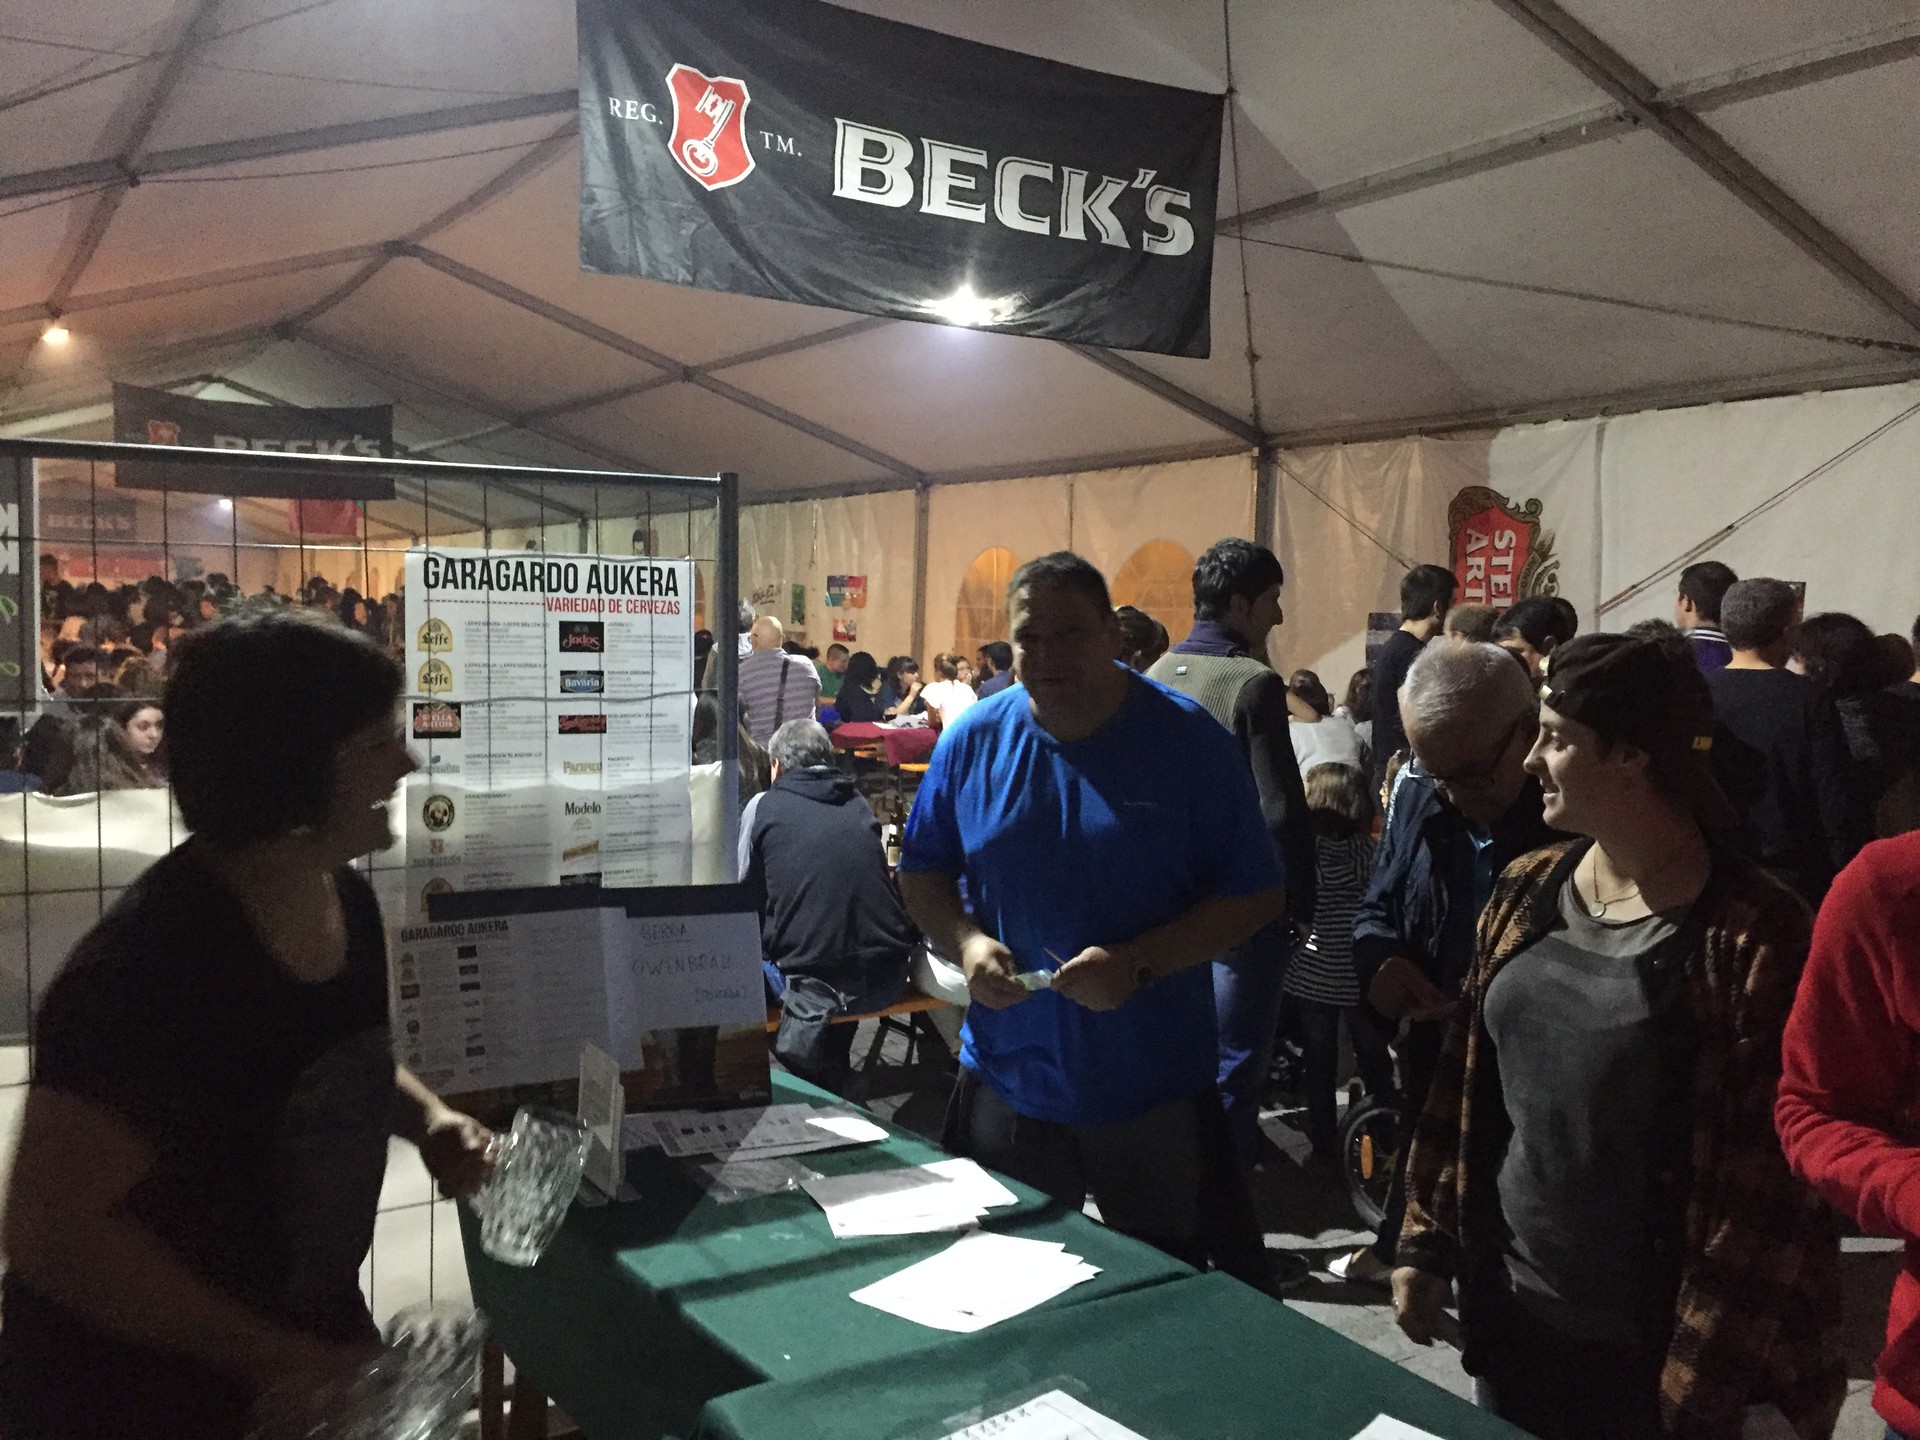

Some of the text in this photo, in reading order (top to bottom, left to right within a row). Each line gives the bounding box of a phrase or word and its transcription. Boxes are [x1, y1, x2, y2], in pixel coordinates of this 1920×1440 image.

[608, 96, 664, 126] REG.
[759, 130, 803, 157] TM.
[832, 117, 1196, 258] BECK'S
[423, 556, 680, 597] GARAGARDO AUKERA
[546, 596, 681, 616] VARIEDAD DE CERVEZAS
[564, 678, 600, 688] Bavaria
[422, 713, 452, 721] SELLA
[564, 801, 602, 816] Modelo
